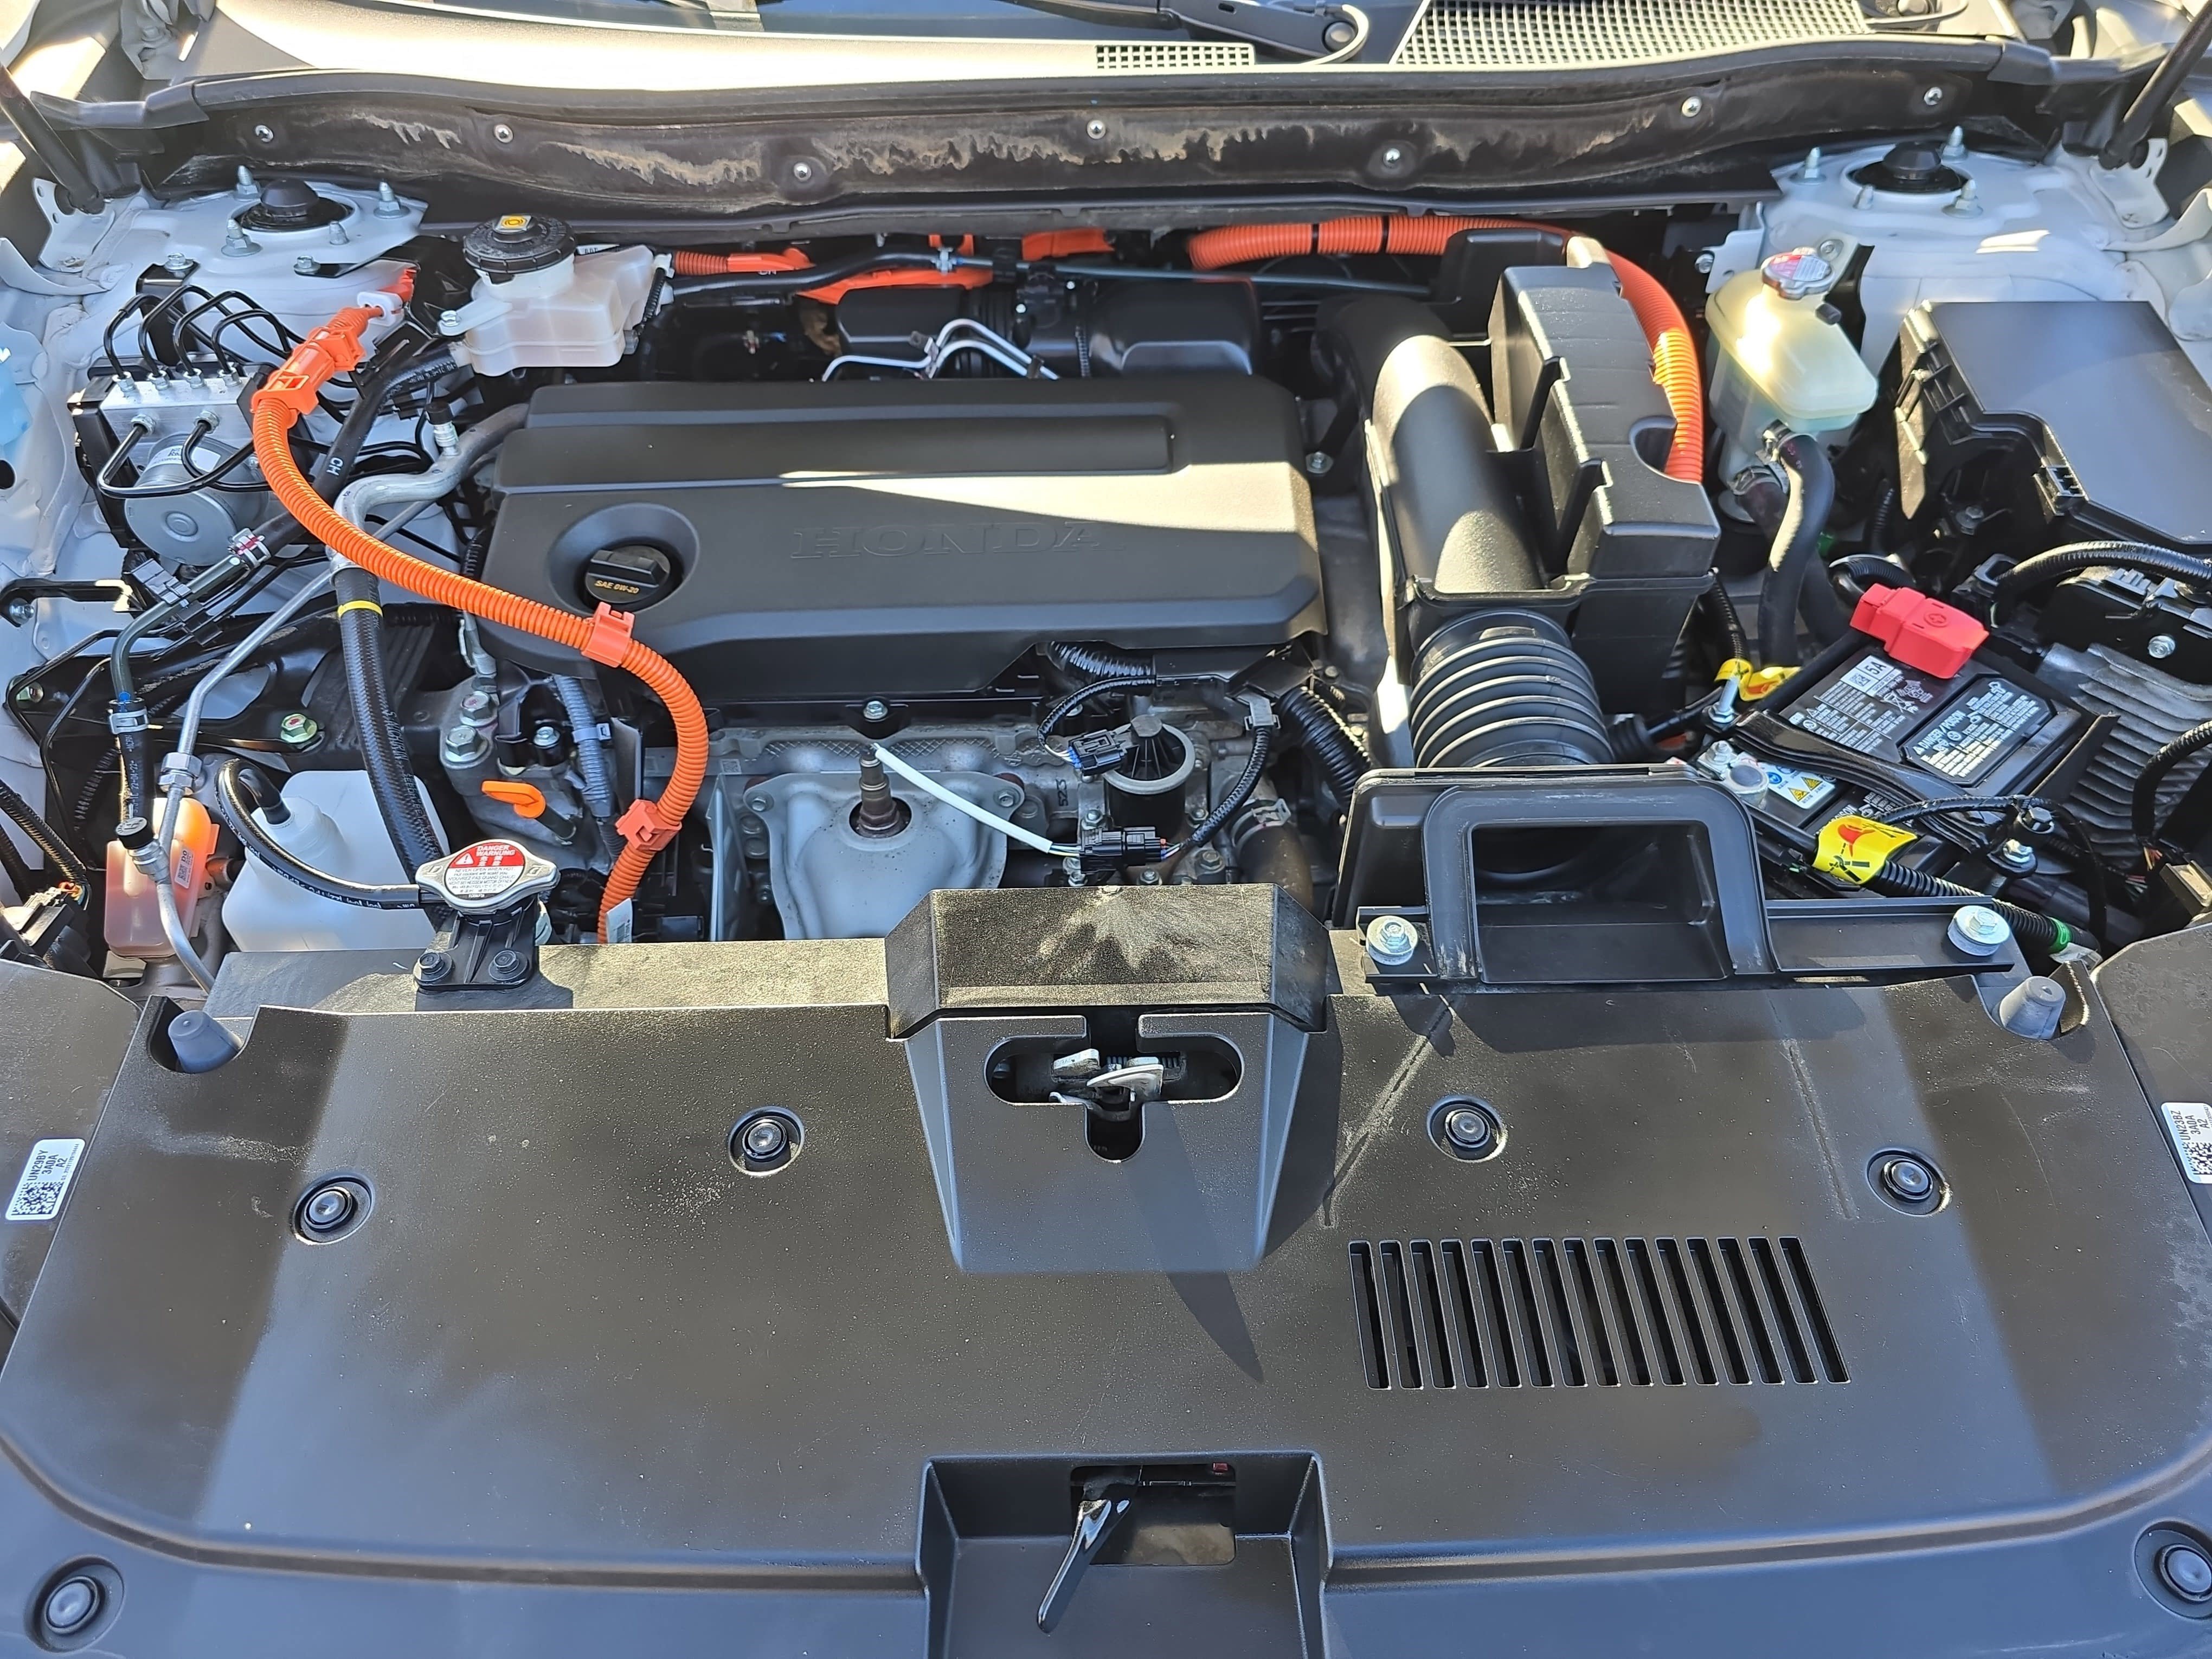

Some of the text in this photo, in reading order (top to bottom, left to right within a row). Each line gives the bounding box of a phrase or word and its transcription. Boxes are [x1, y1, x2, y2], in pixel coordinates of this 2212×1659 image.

[326, 457, 343, 476] CH
[790, 522, 1126, 559] HONDA
[594, 580, 640, 594] SAE 0W-20
[1863, 661, 1887, 676] 5A
[1056, 778, 1069, 806] 523
[2170, 1110, 2191, 1140] UN23BZ
[2197, 1118, 2210, 1129] A2
[27, 1150, 48, 1181] UN29BY
[55, 1158, 68, 1168] A2
